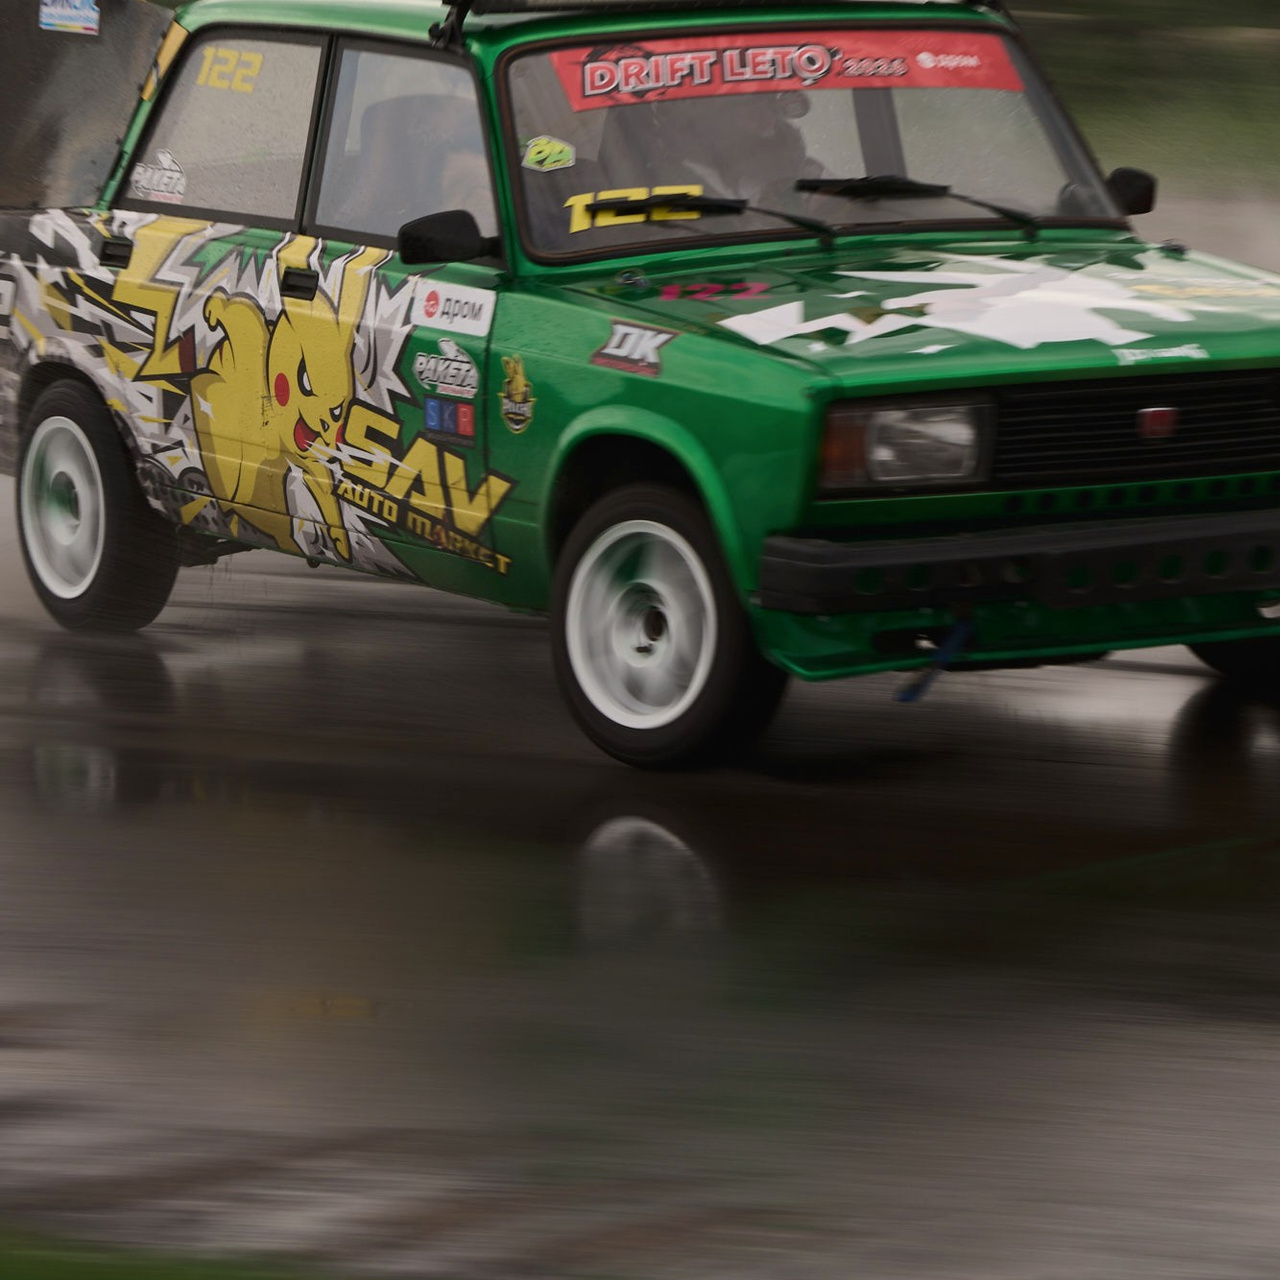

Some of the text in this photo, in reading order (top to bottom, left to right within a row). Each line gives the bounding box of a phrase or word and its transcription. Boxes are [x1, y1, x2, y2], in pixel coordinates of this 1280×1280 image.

[196, 46, 264, 93] 122
[584, 50, 718, 96] DRIFT
[723, 45, 834, 86] LETO
[660, 282, 772, 301] 122
[343, 404, 512, 538] SAV
[337, 478, 399, 523] AUTO
